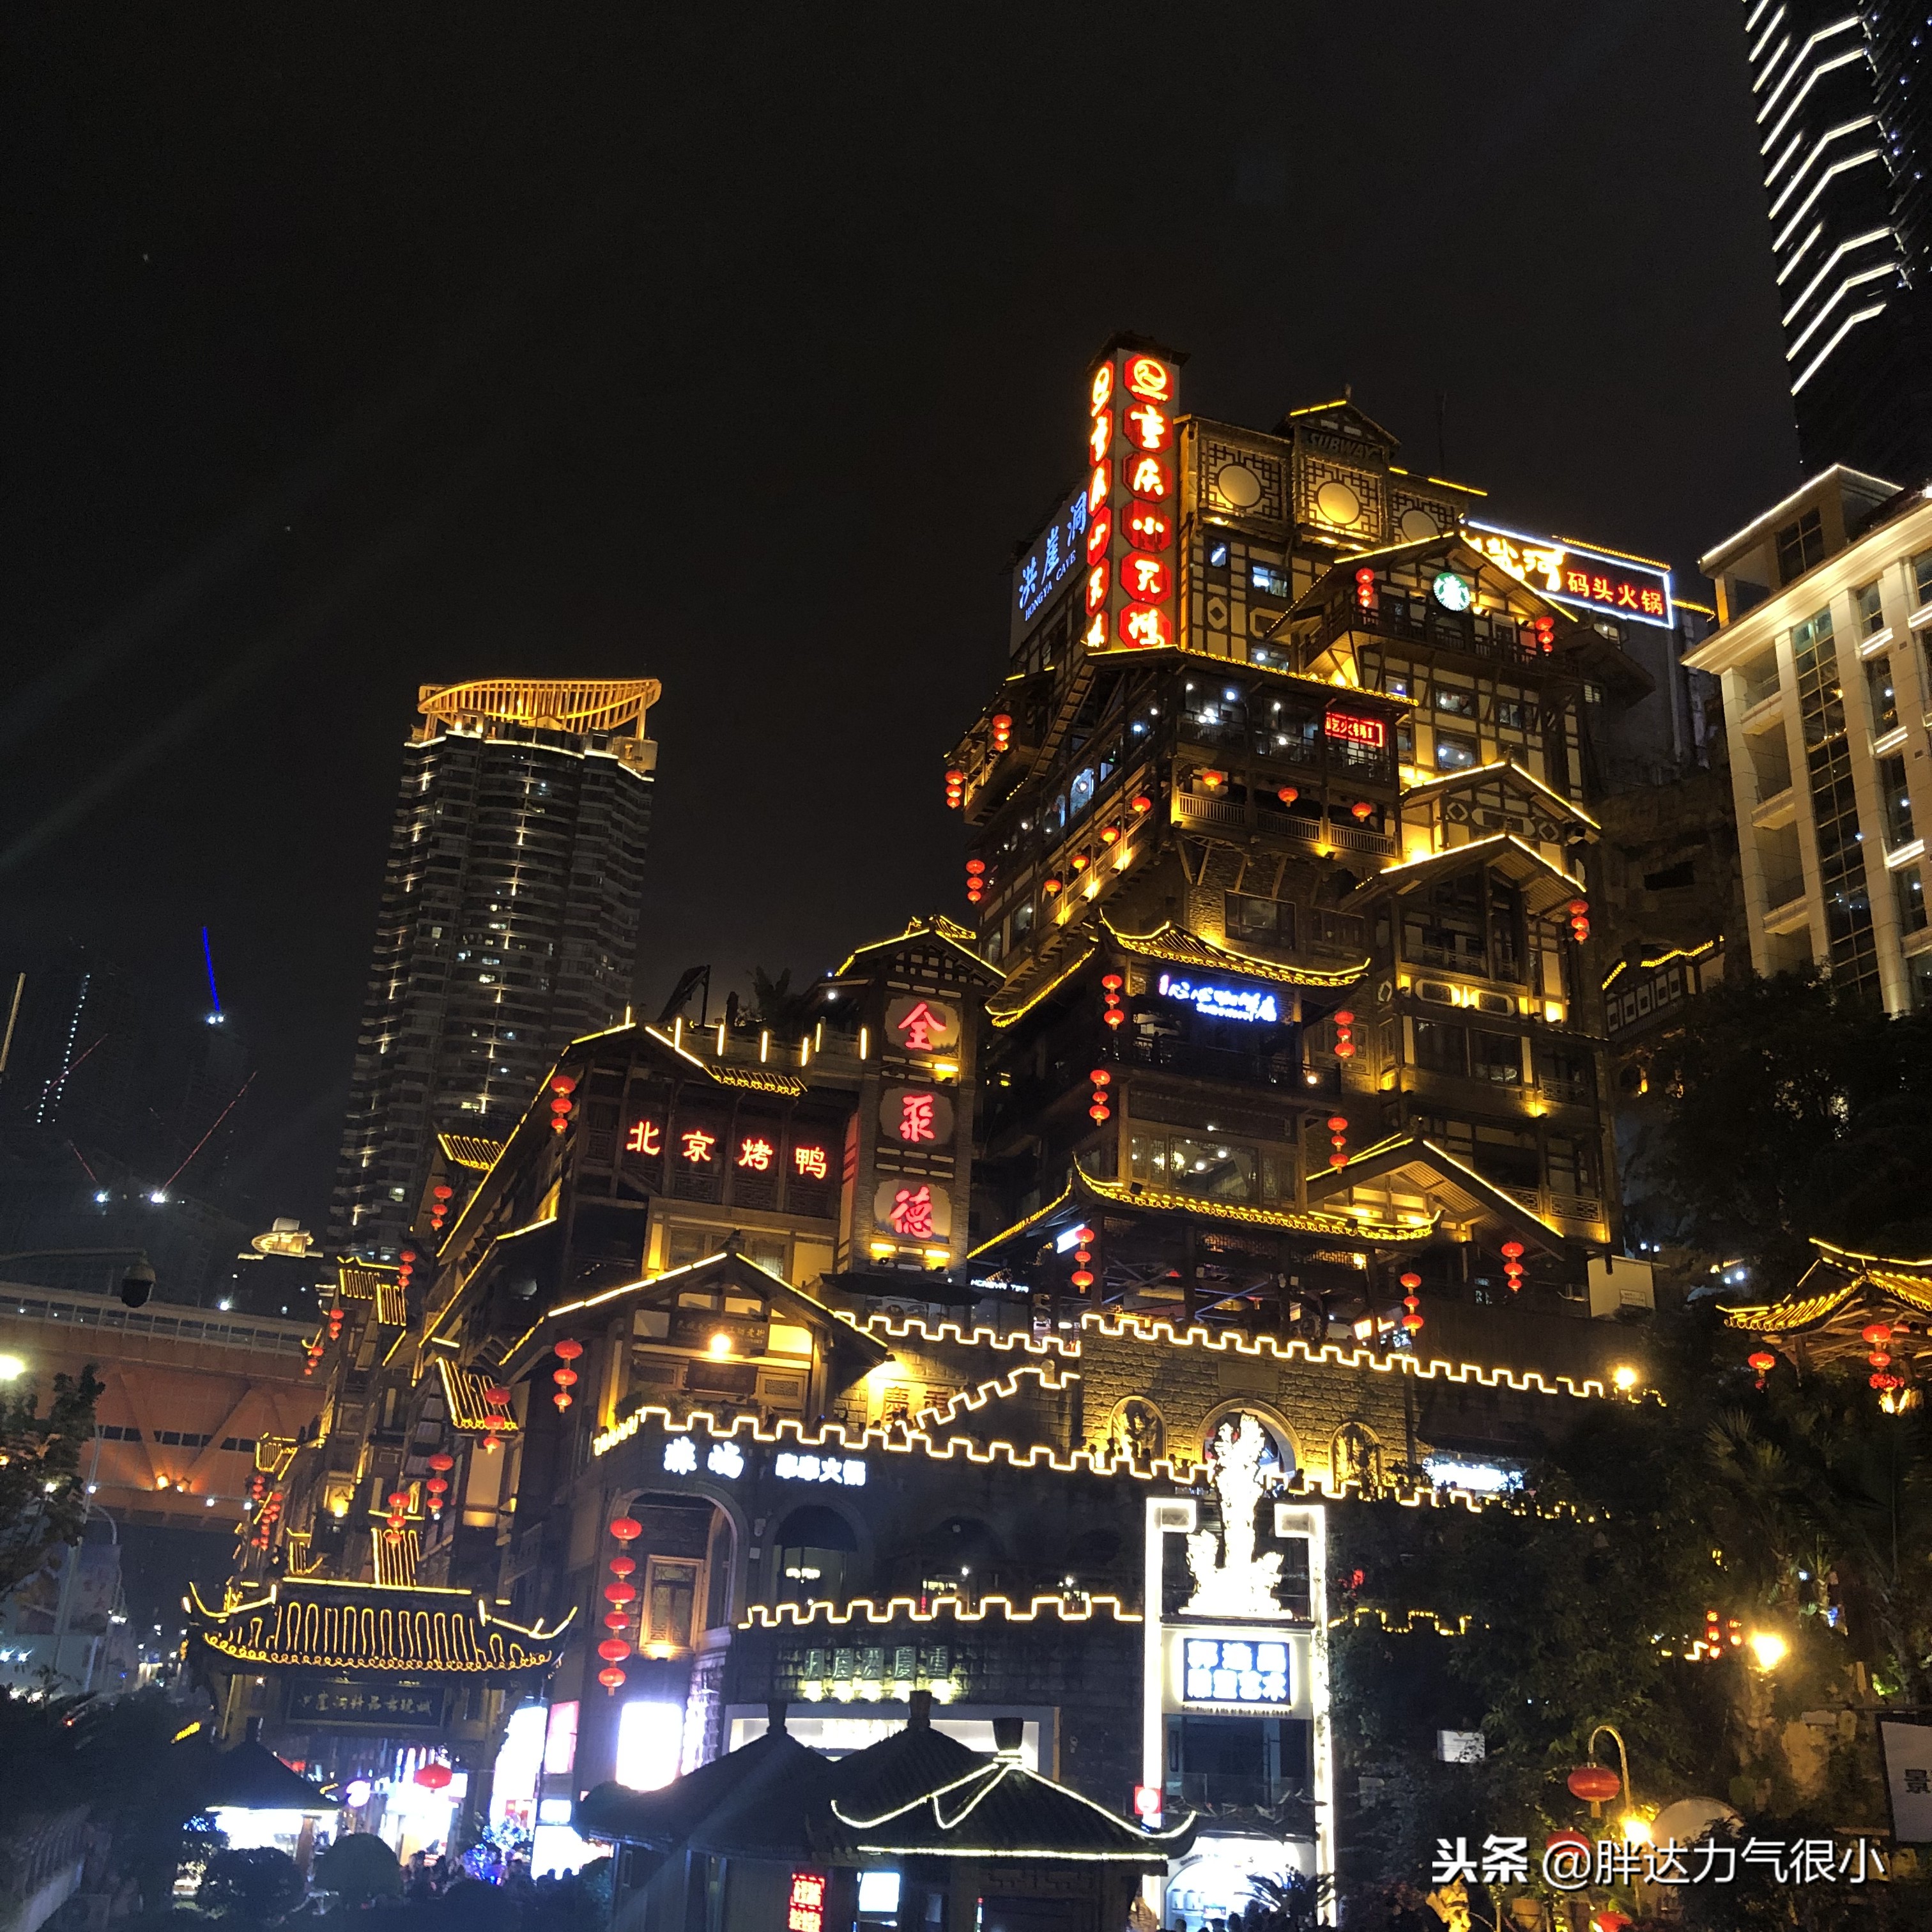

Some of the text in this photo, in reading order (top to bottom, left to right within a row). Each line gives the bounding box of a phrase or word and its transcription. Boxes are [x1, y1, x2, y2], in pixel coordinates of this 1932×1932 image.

[1310, 433, 1381, 459] SUBWAY
[1018, 491, 1087, 610] 洪崖洞
[1128, 404, 1165, 646] 重庆小天鹅
[1024, 549, 1077, 622] HONGYA CAVE
[1567, 571, 1664, 615] 码头火锅
[625, 1120, 827, 1180] 北京烤鸭
[1904, 1768, 1932, 1795] 景
